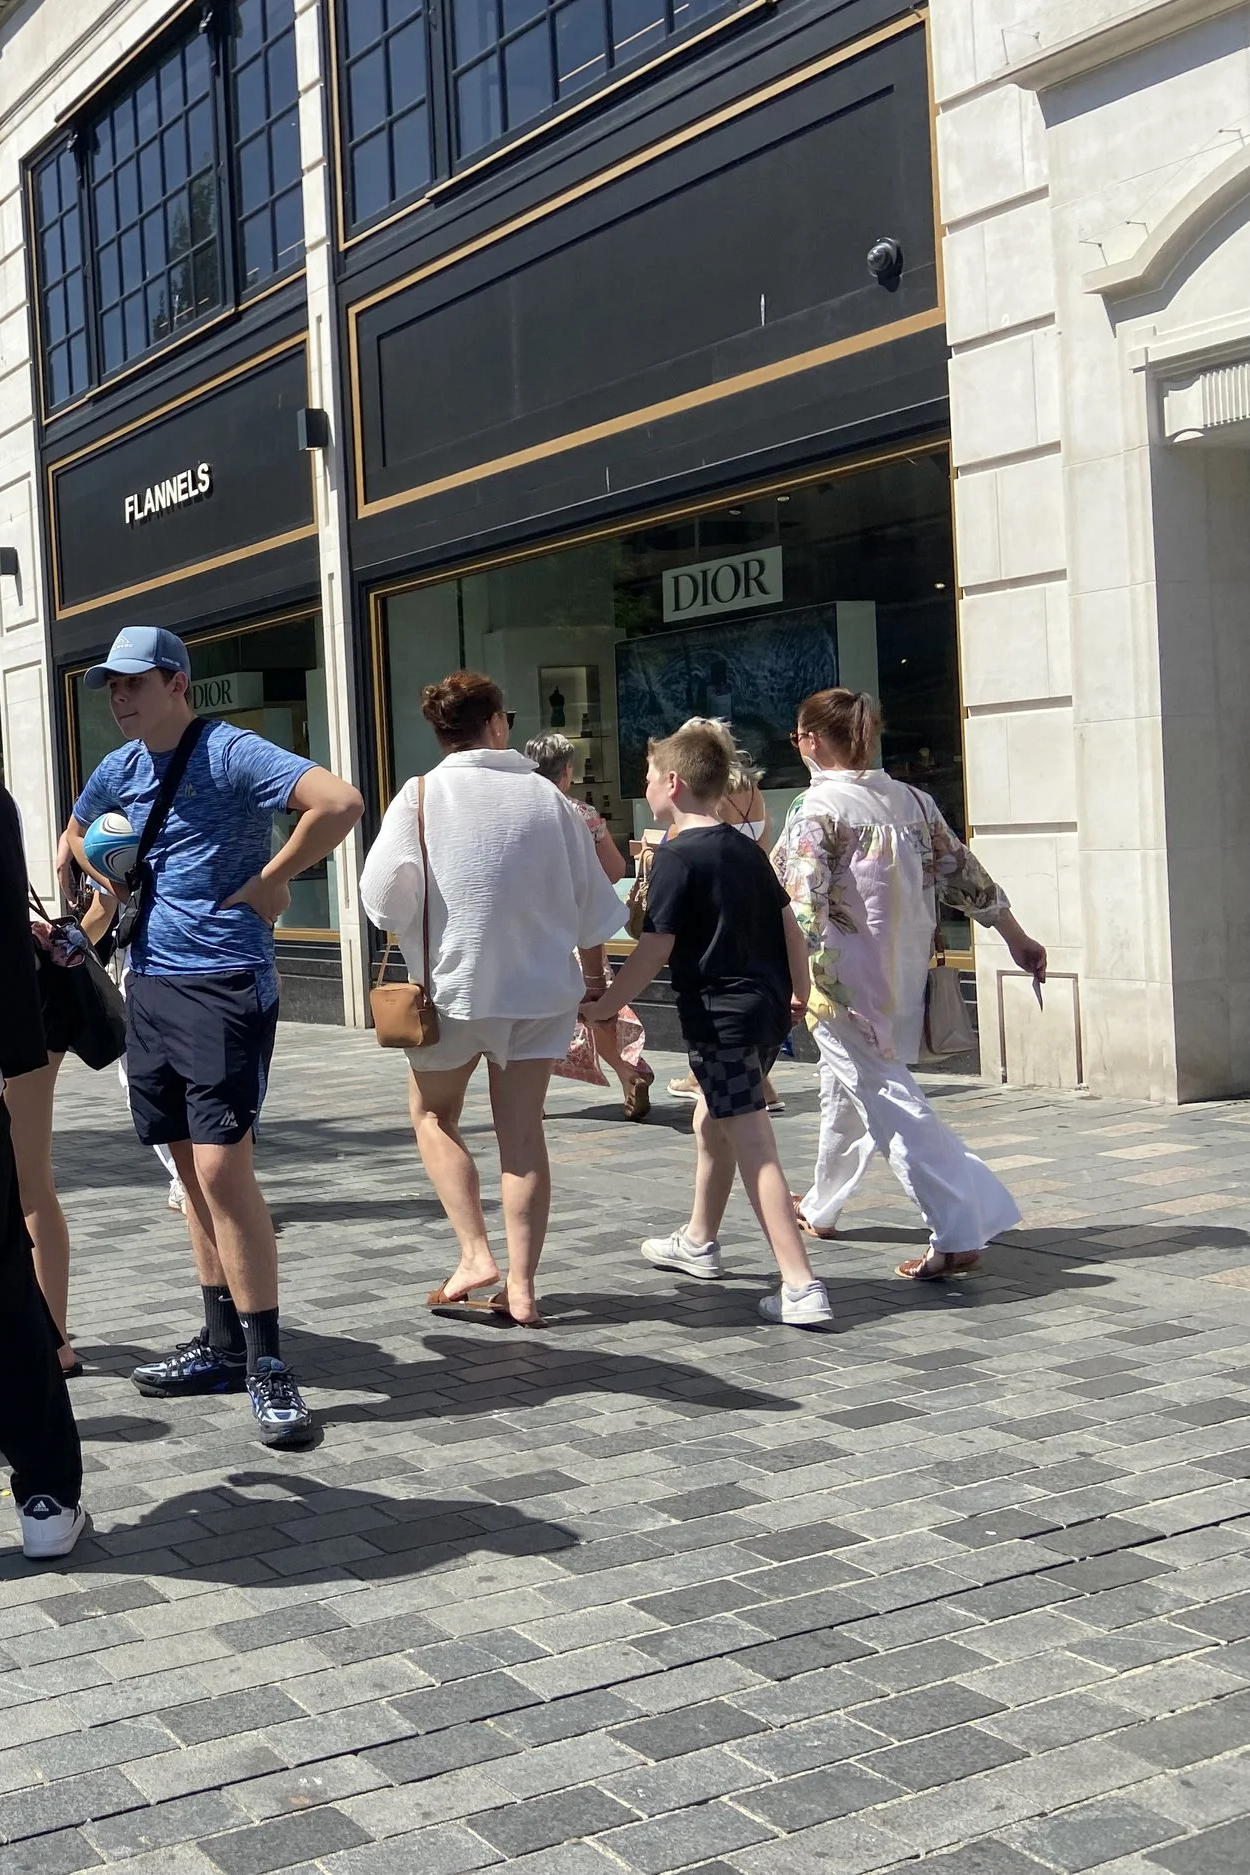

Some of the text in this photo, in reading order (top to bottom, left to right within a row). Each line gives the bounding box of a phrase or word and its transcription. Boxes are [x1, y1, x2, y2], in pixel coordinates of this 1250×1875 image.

[125, 462, 210, 524] FLANNELS
[670, 558, 772, 613] DIOR
[192, 678, 233, 710] DIOR
